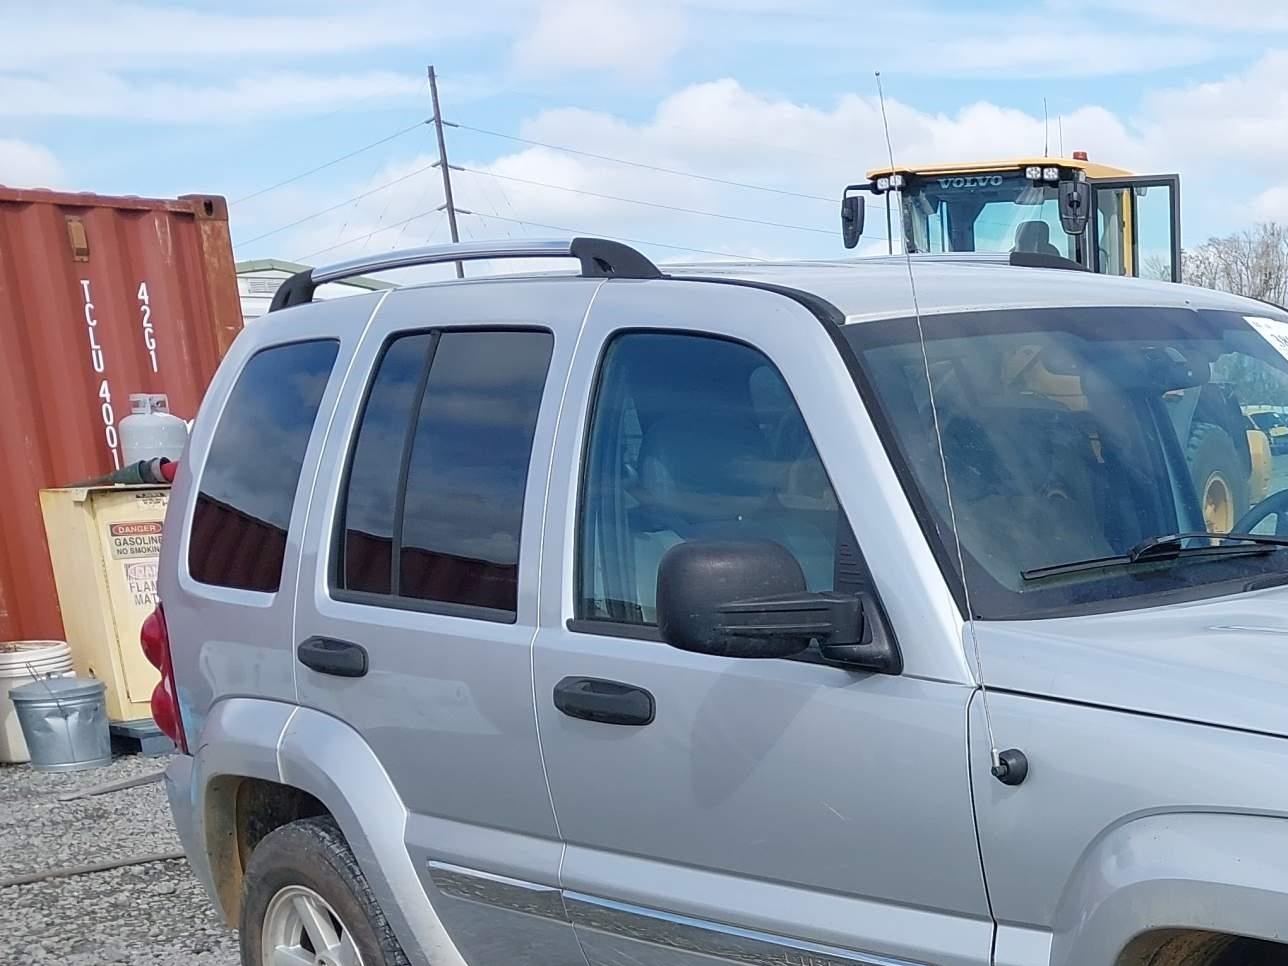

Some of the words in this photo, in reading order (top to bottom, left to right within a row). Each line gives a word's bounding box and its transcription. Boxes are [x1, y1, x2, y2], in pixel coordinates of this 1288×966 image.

[937, 175, 1003, 189] VOLVO
[80, 279, 105, 373] TCLU
[137, 282, 158, 373] 42G1
[118, 524, 156, 534] DANGER
[116, 547, 128, 555] NO
